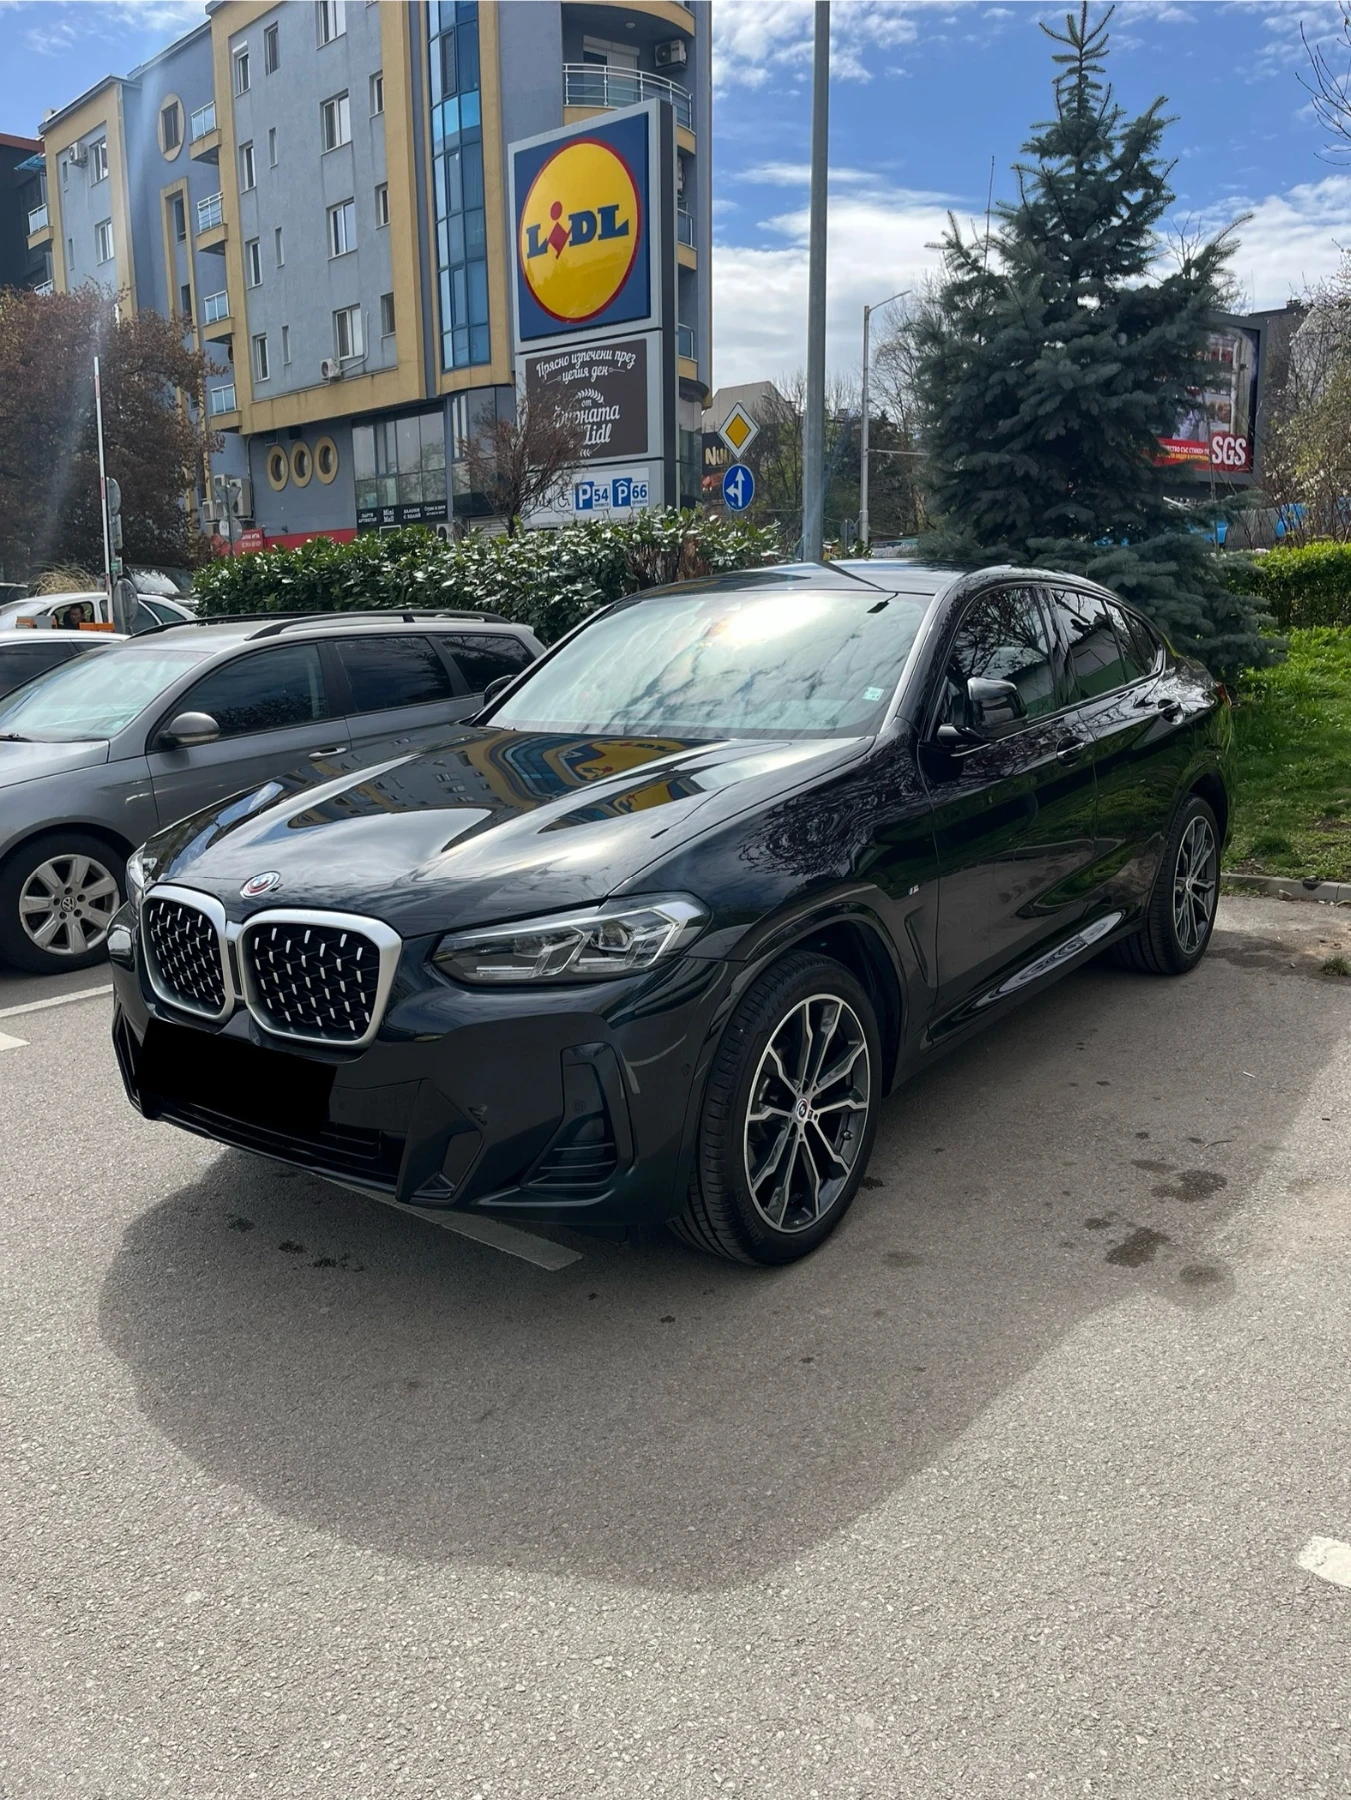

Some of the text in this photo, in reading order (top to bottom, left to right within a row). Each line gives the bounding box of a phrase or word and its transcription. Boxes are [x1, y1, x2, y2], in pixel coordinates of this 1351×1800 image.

[536, 350, 636, 380] Прясно изпечени през
[562, 365, 608, 384] целия ден
[583, 423, 612, 445] Lidl
[1211, 436, 1247, 466] SGS
[579, 484, 609, 508] P 54
[618, 484, 647, 504] P 66
